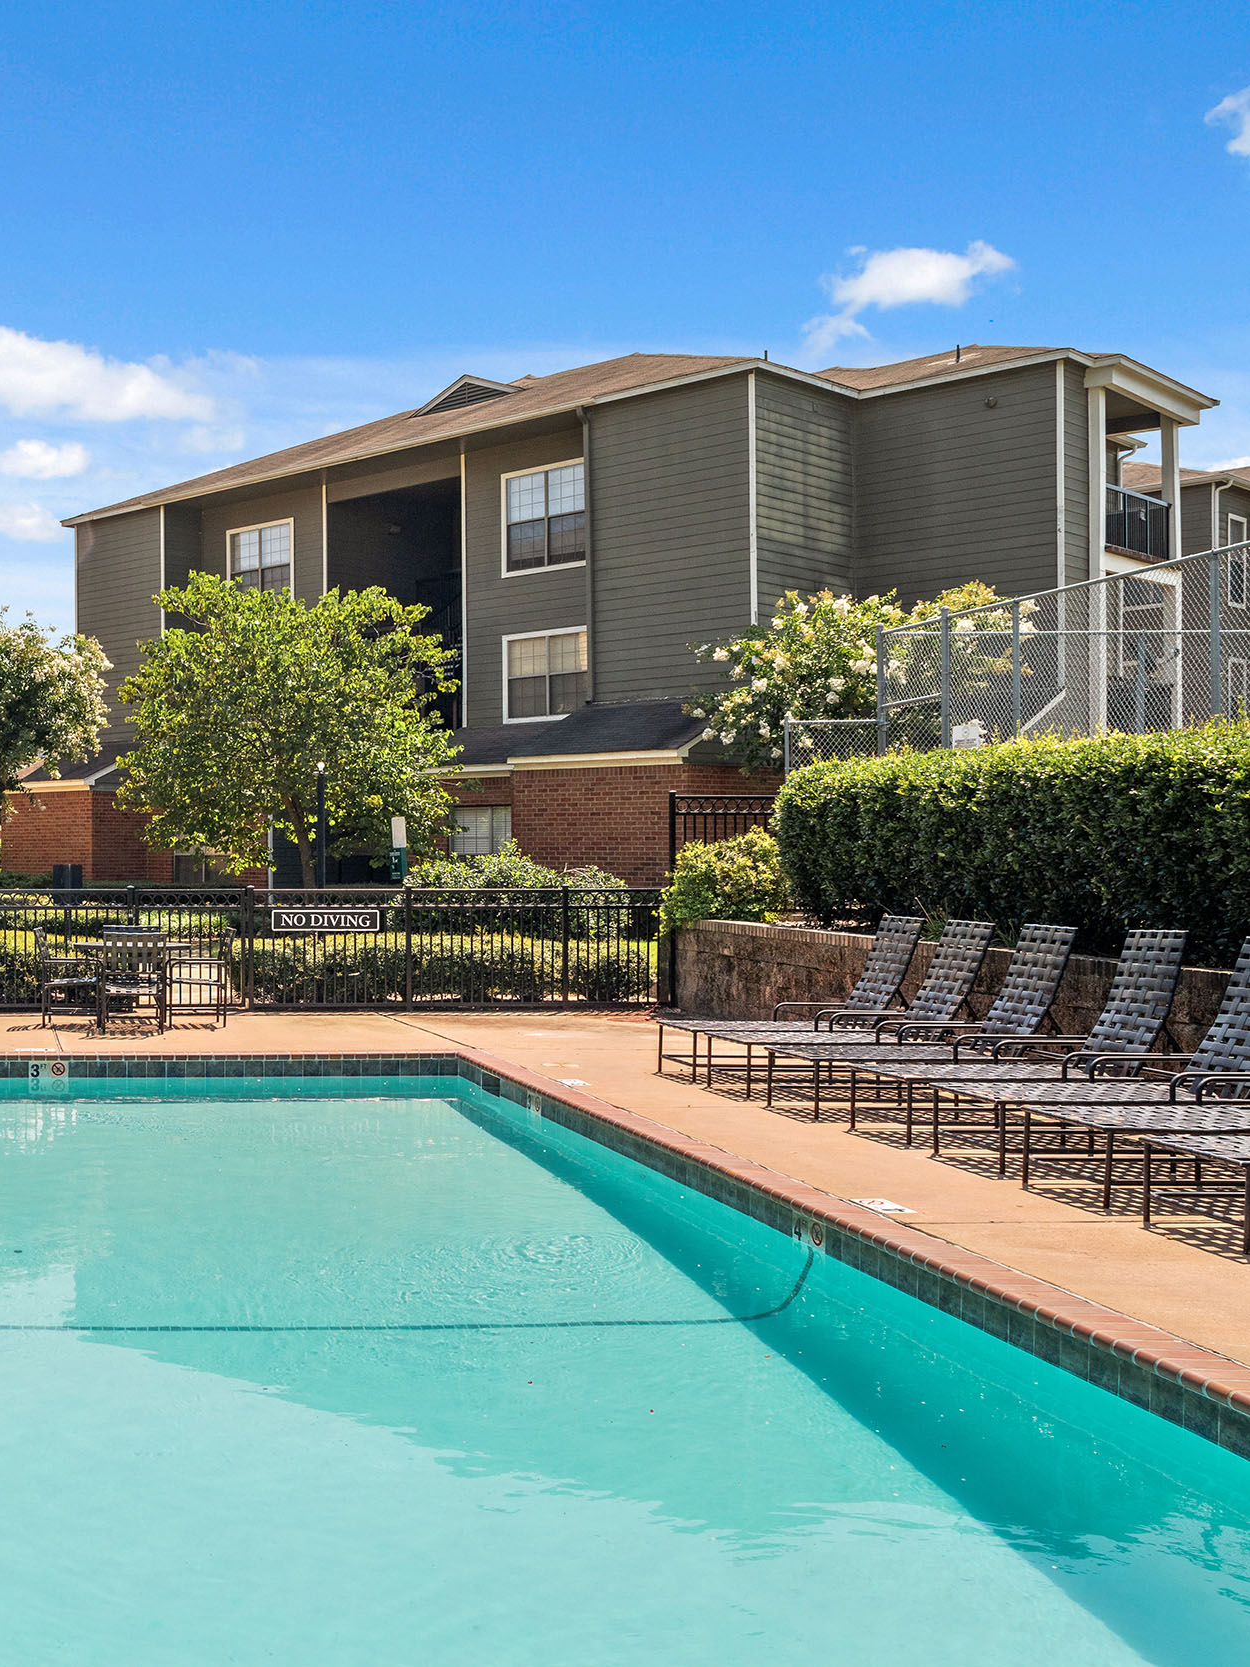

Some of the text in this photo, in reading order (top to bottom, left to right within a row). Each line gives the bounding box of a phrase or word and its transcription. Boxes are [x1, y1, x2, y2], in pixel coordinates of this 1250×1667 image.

[280, 914, 371, 927] NO DIVING
[30, 1063, 40, 1078] 3
[793, 1218, 802, 1240] 4
